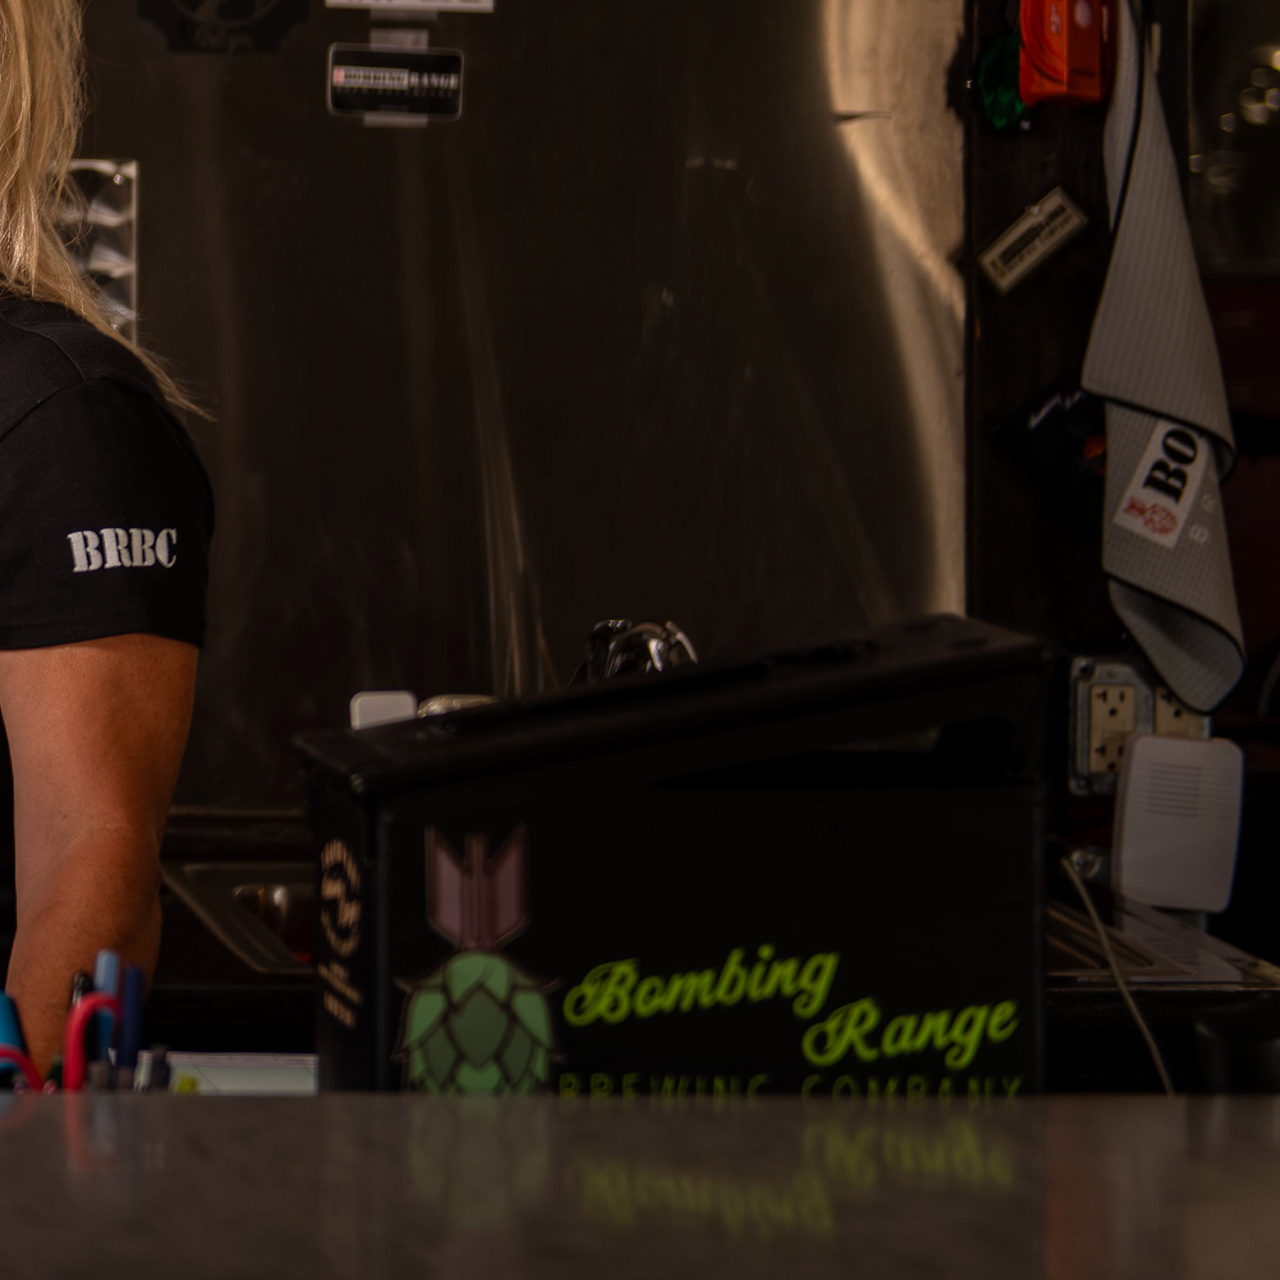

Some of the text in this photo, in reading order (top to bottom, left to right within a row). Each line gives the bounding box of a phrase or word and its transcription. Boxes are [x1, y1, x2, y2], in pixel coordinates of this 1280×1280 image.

[67, 528, 177, 572] BRBC
[562, 945, 840, 1028] Bombing
[801, 998, 1019, 1069] Range
